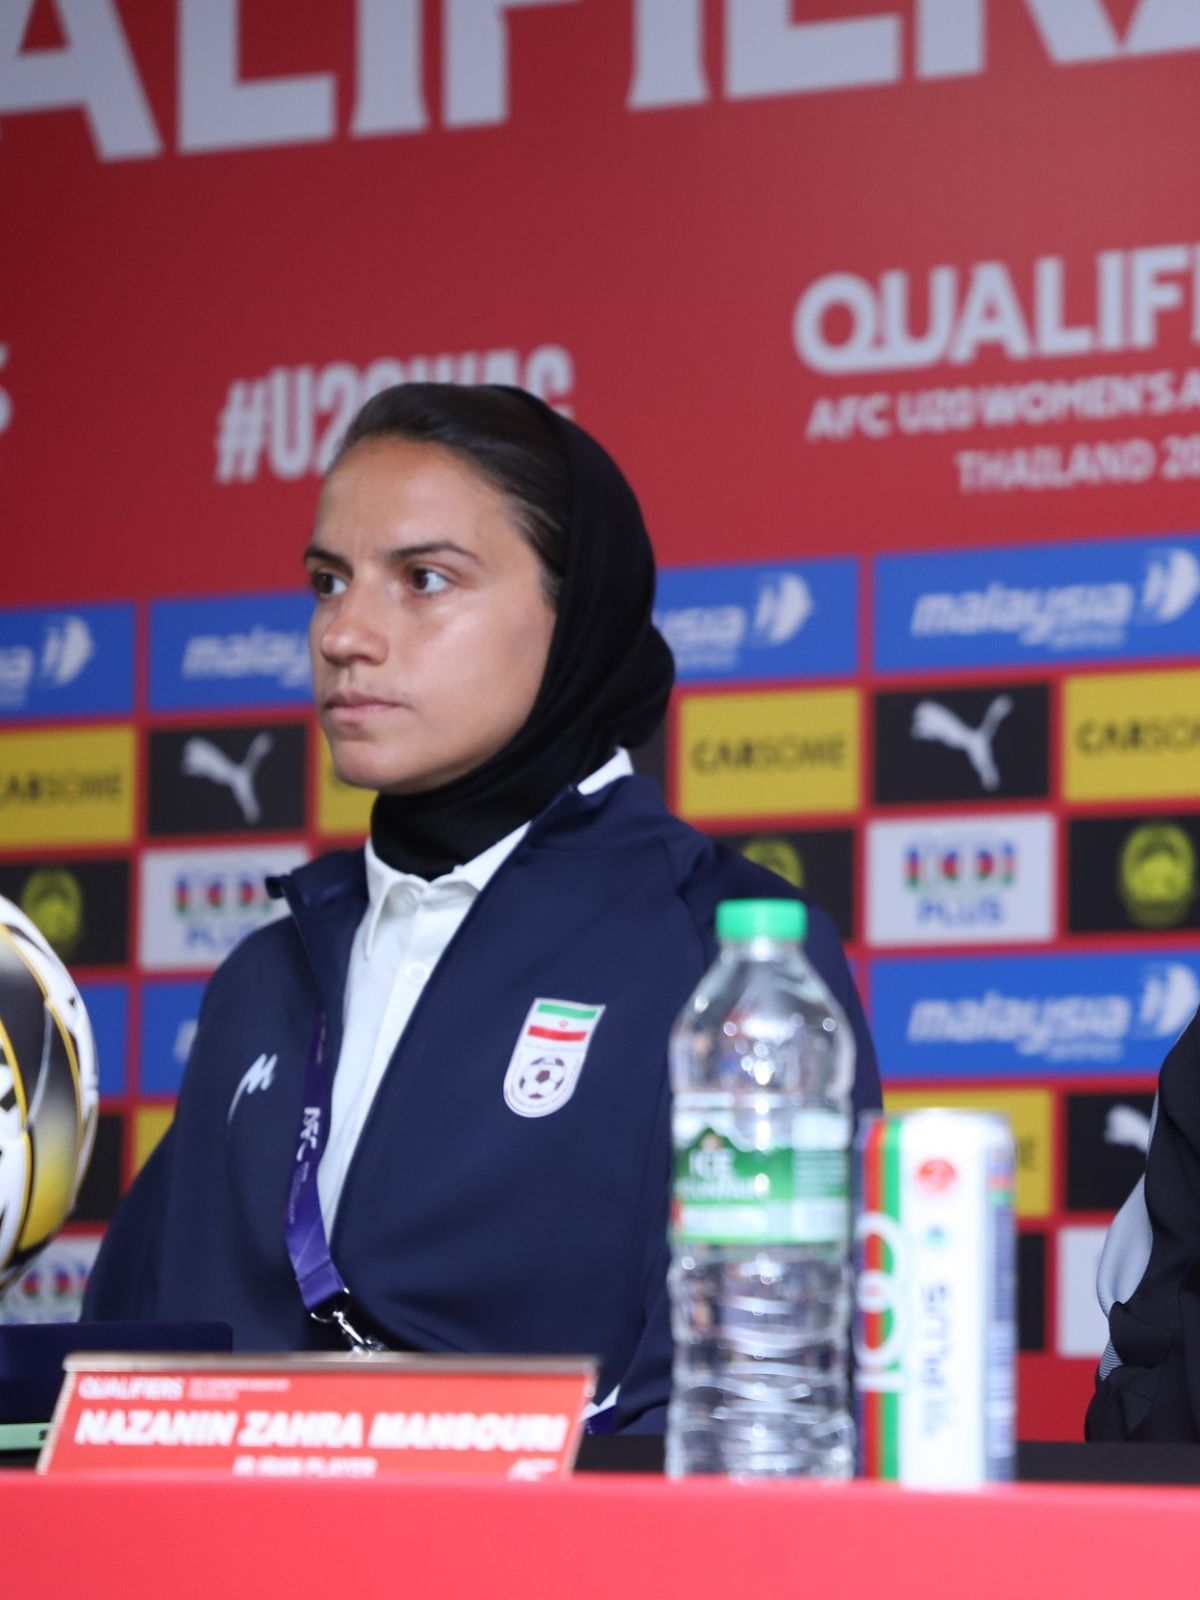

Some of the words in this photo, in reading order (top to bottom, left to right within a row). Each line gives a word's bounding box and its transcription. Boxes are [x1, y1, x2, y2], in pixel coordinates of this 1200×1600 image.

[805, 391, 891, 441] AFC
[978, 369, 1176, 426] WOMEN'S
[955, 437, 1156, 495] THAILAND
[74, 1408, 238, 1445] NAZANIN
[236, 1410, 364, 1448] ZAHRA
[367, 1411, 569, 1452] MANSOURI
